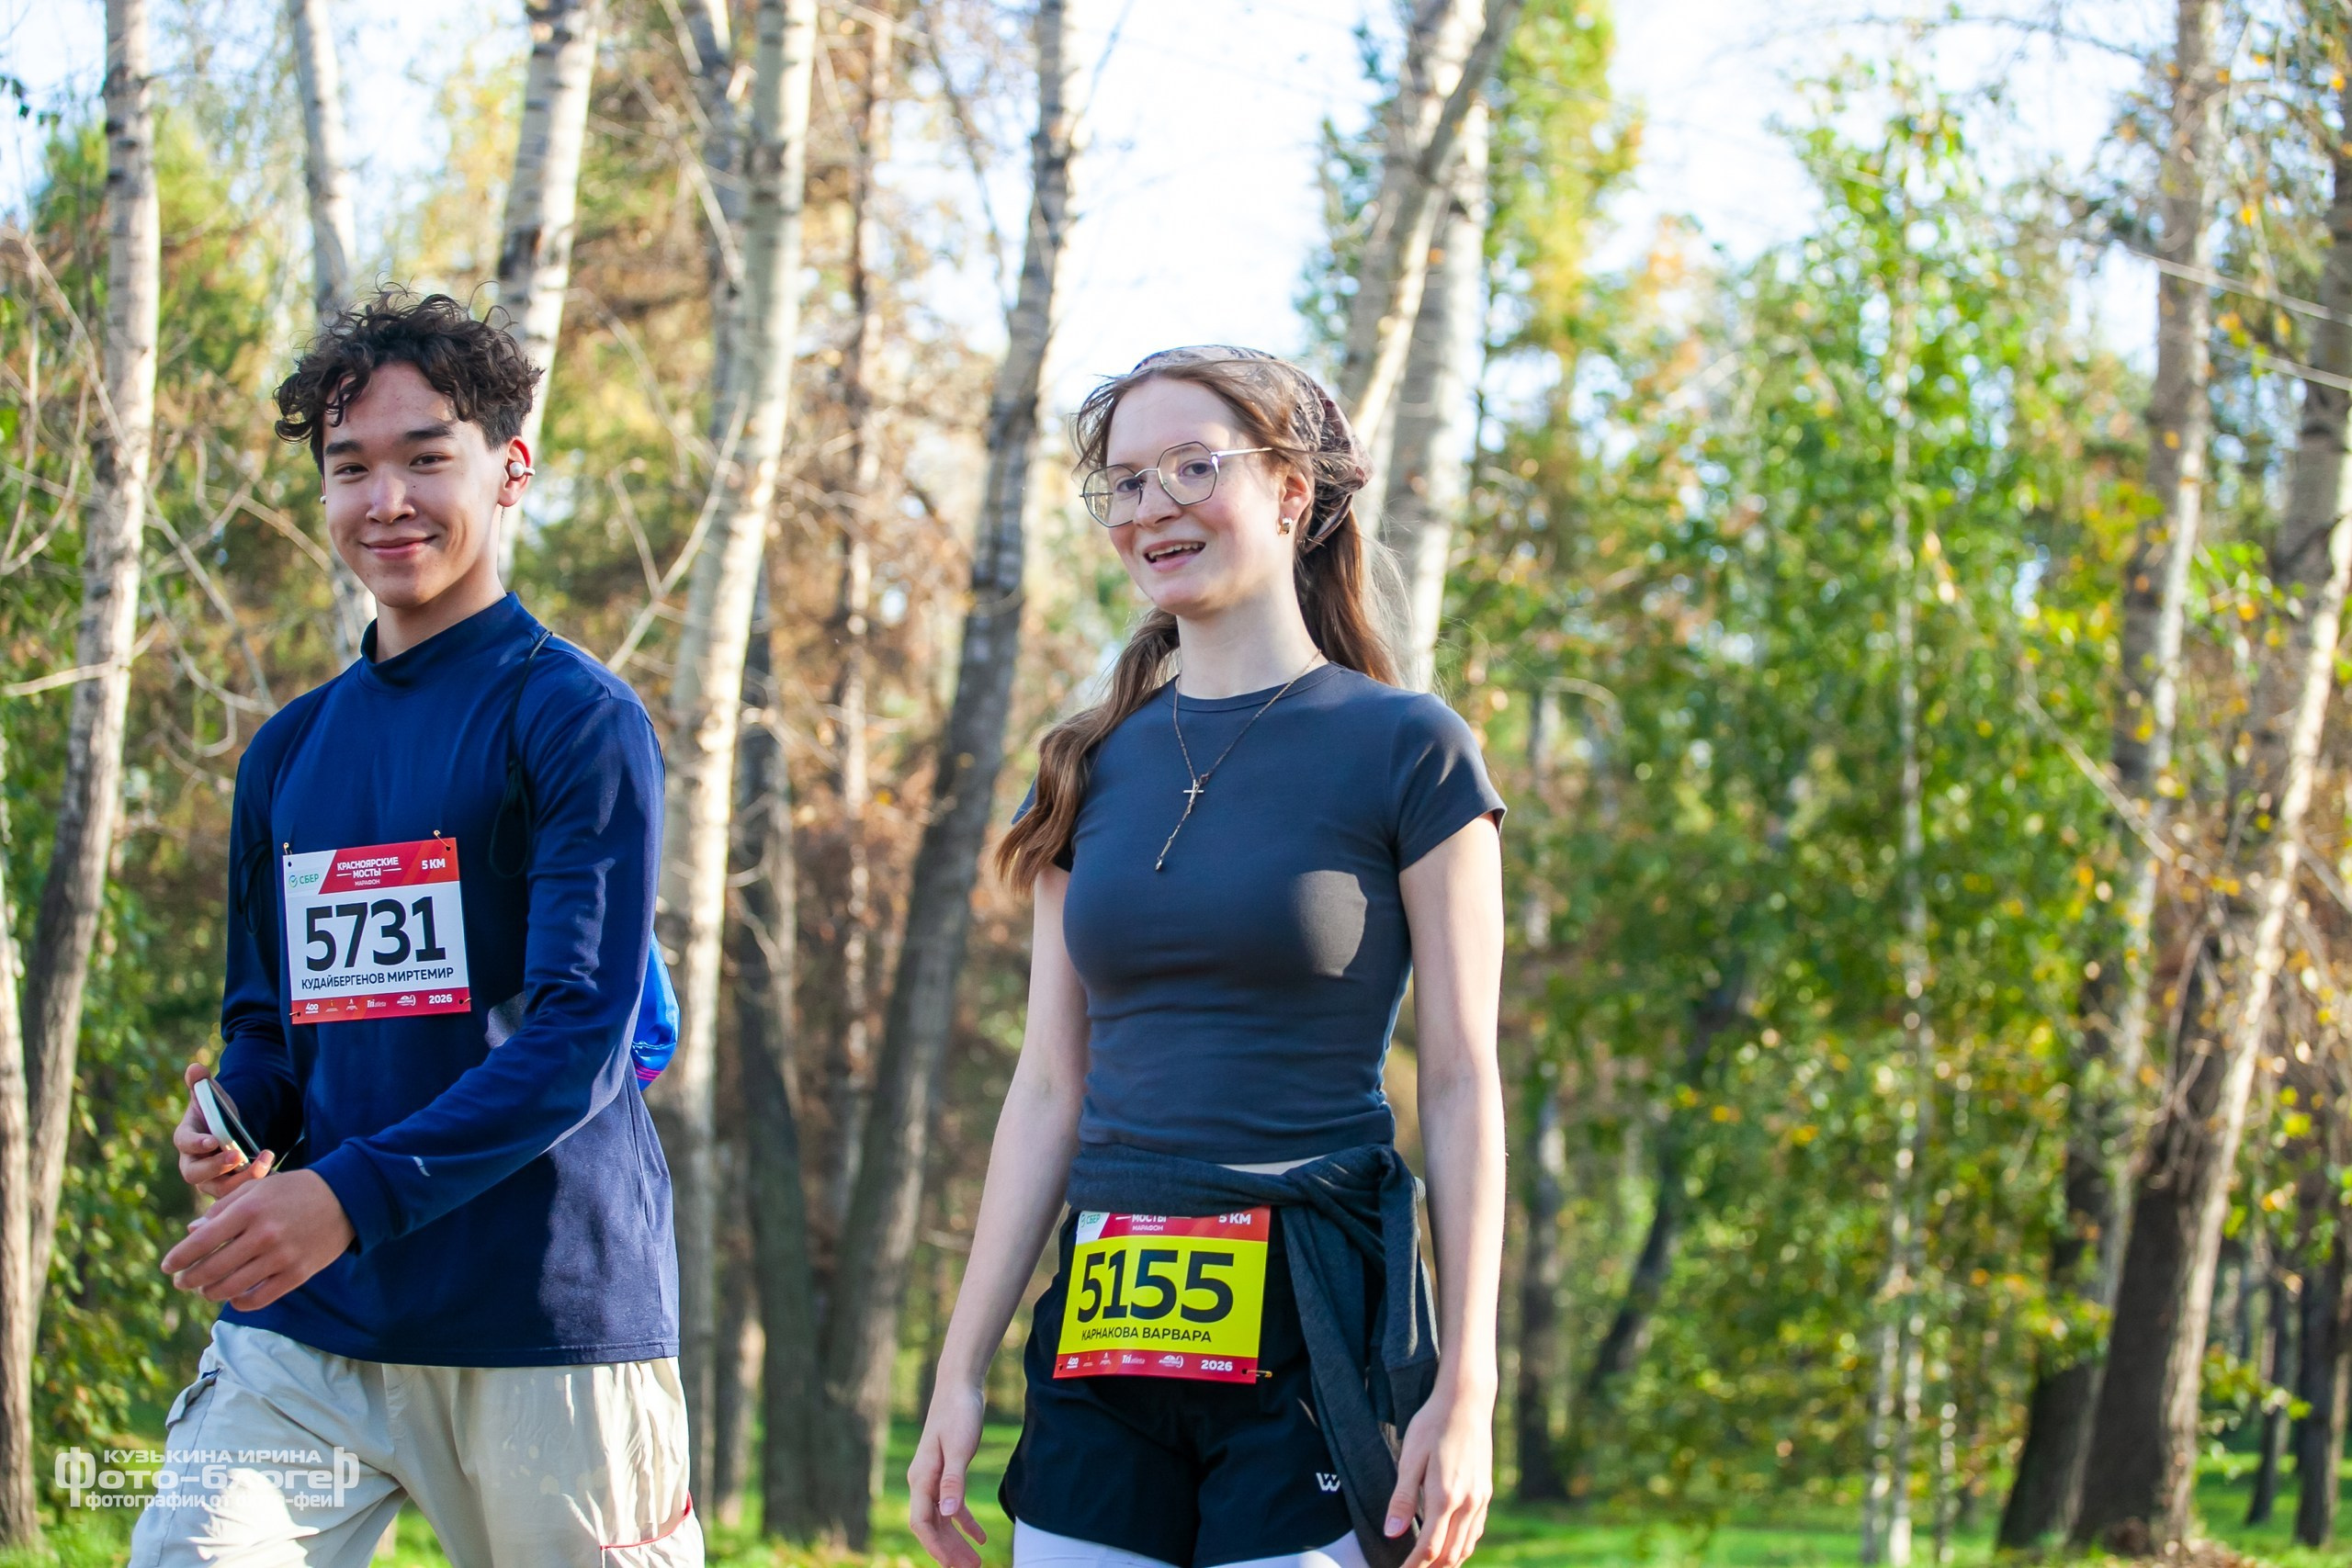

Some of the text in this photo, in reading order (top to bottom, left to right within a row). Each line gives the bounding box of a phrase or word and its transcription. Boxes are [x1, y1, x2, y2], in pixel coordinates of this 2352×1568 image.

[337, 856, 399, 871] КРАСНОЯРСКИЕ
[422, 860, 428, 870] 5
[353, 868, 381, 879] МОСТЫ
[300, 874, 319, 885] СБЕР
[306, 896, 447, 972] 5731
[301, 967, 454, 990] КУДАЙБЕРГЕНОВ МИРТЕМИР
[428, 994, 453, 1005] 2026
[1132, 1213, 1167, 1223] МОСТЫ
[1218, 1214, 1227, 1224] 5
[1077, 1249, 1235, 1323] 5155
[1081, 1326, 1212, 1343] КАРНАКОВА ВАРВАРА
[1201, 1359, 1233, 1371] 2026
